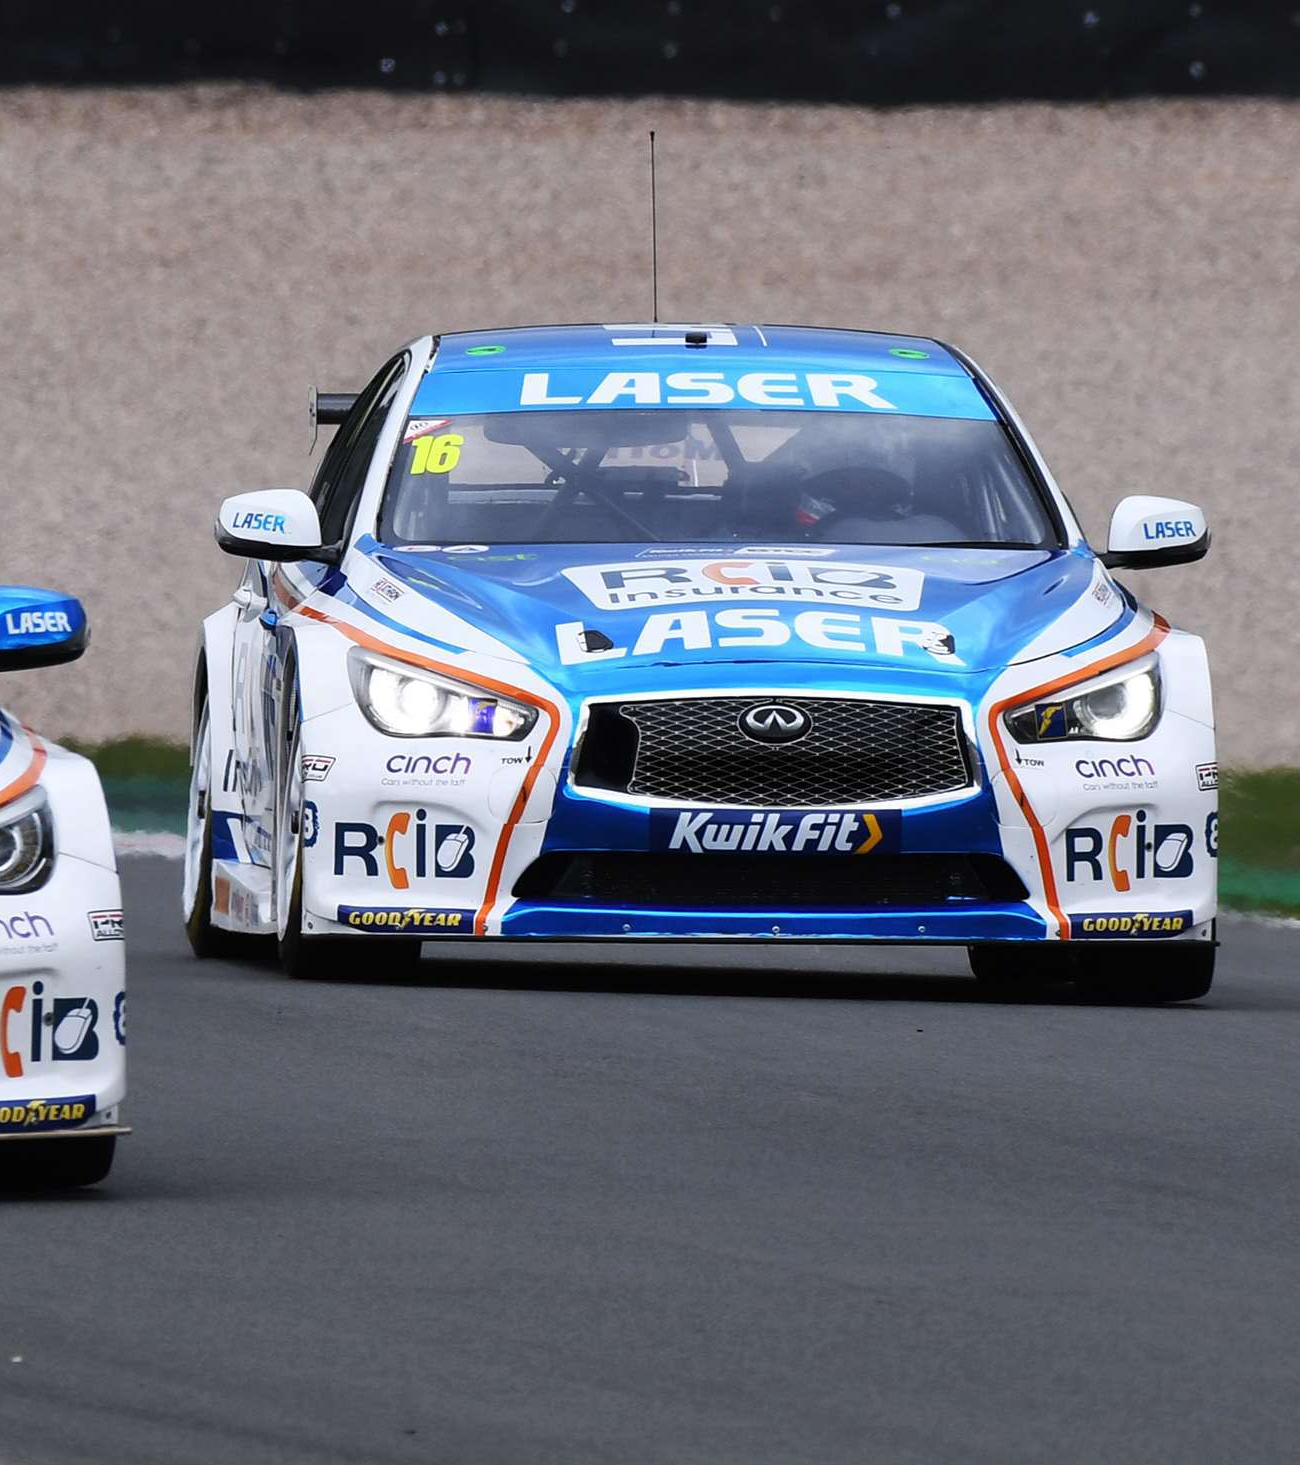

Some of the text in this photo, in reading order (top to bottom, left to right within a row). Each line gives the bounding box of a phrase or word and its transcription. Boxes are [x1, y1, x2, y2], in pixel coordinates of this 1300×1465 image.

[520, 373, 899, 409] LASER
[410, 434, 464, 475] 16
[232, 512, 286, 534] LASER
[1143, 520, 1197, 540] LASER
[609, 583, 903, 604] Insurance
[5, 611, 72, 635] LASER
[554, 609, 967, 665] LASER
[386, 752, 472, 775] cinch
[1024, 759, 1045, 767] TOW
[1075, 755, 1156, 778] cinch
[349, 910, 461, 928] GOODYEAR
[1083, 915, 1184, 933] GOODYEAR
